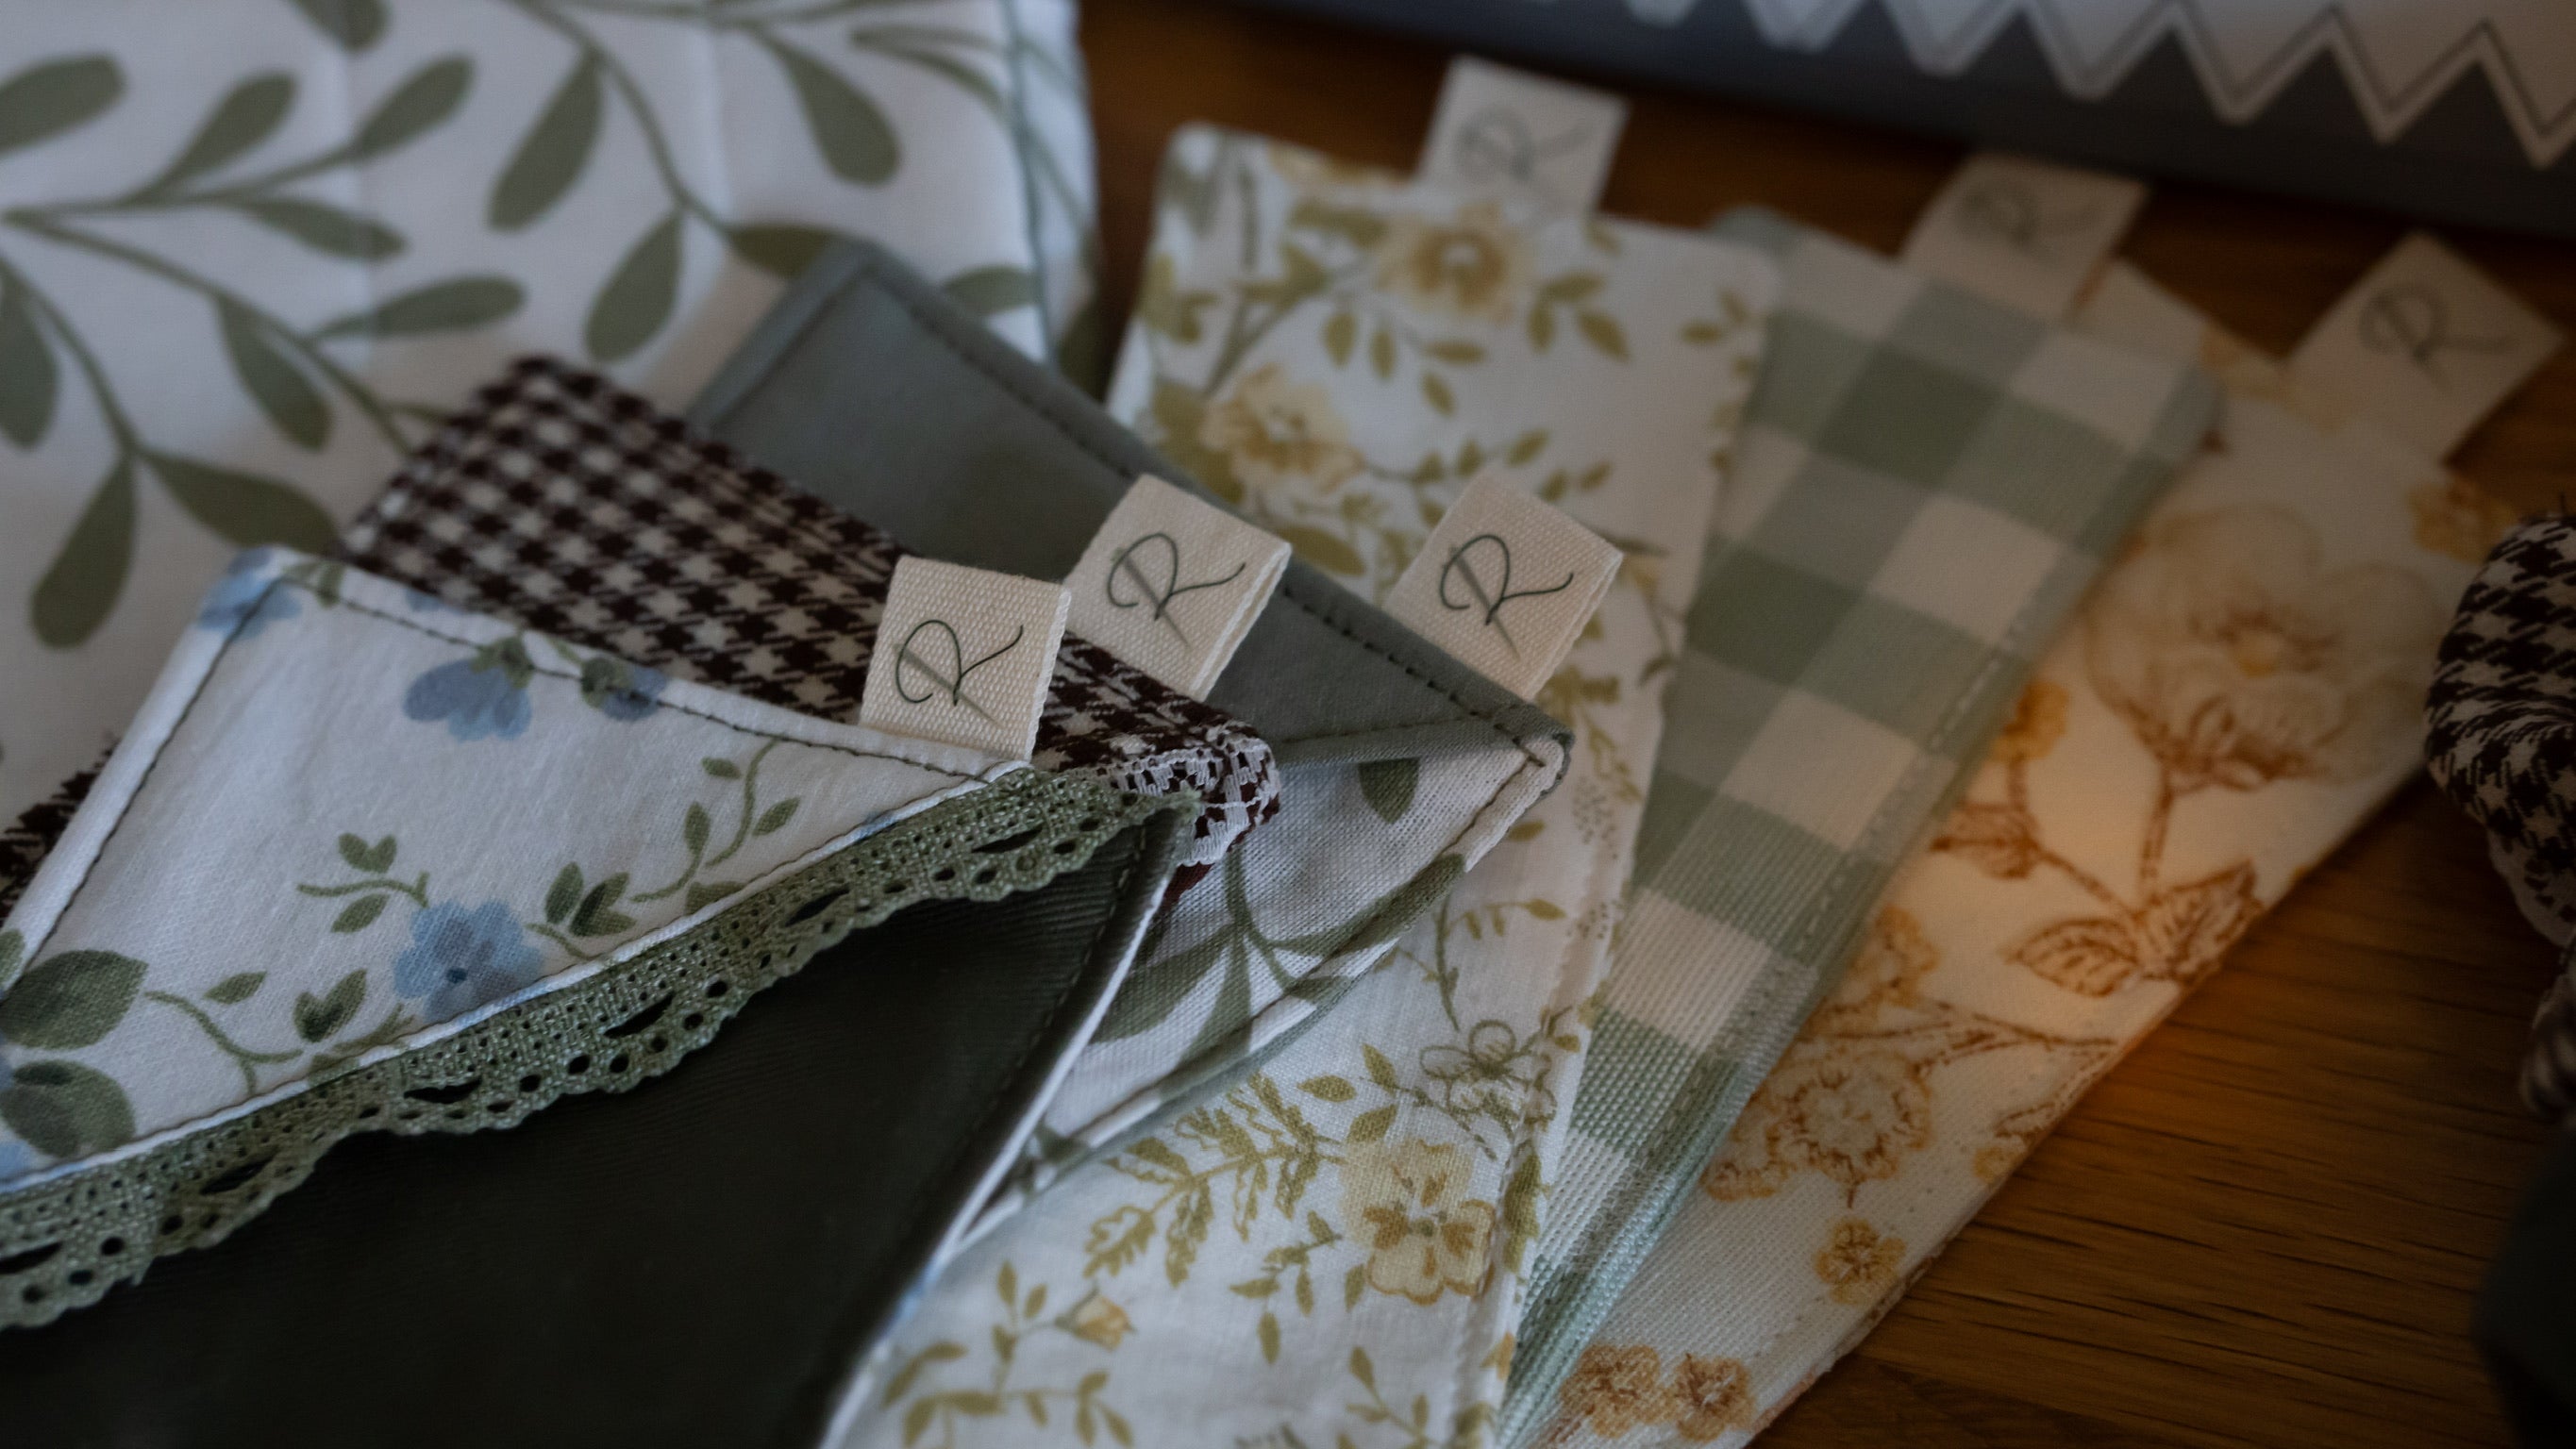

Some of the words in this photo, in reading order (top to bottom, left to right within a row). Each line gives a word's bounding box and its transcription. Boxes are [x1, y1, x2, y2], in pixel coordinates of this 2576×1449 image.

[2359, 285, 2511, 389] R
[1106, 532, 1246, 649] R
[1438, 534, 1574, 658] R
[895, 620, 1024, 726] R
